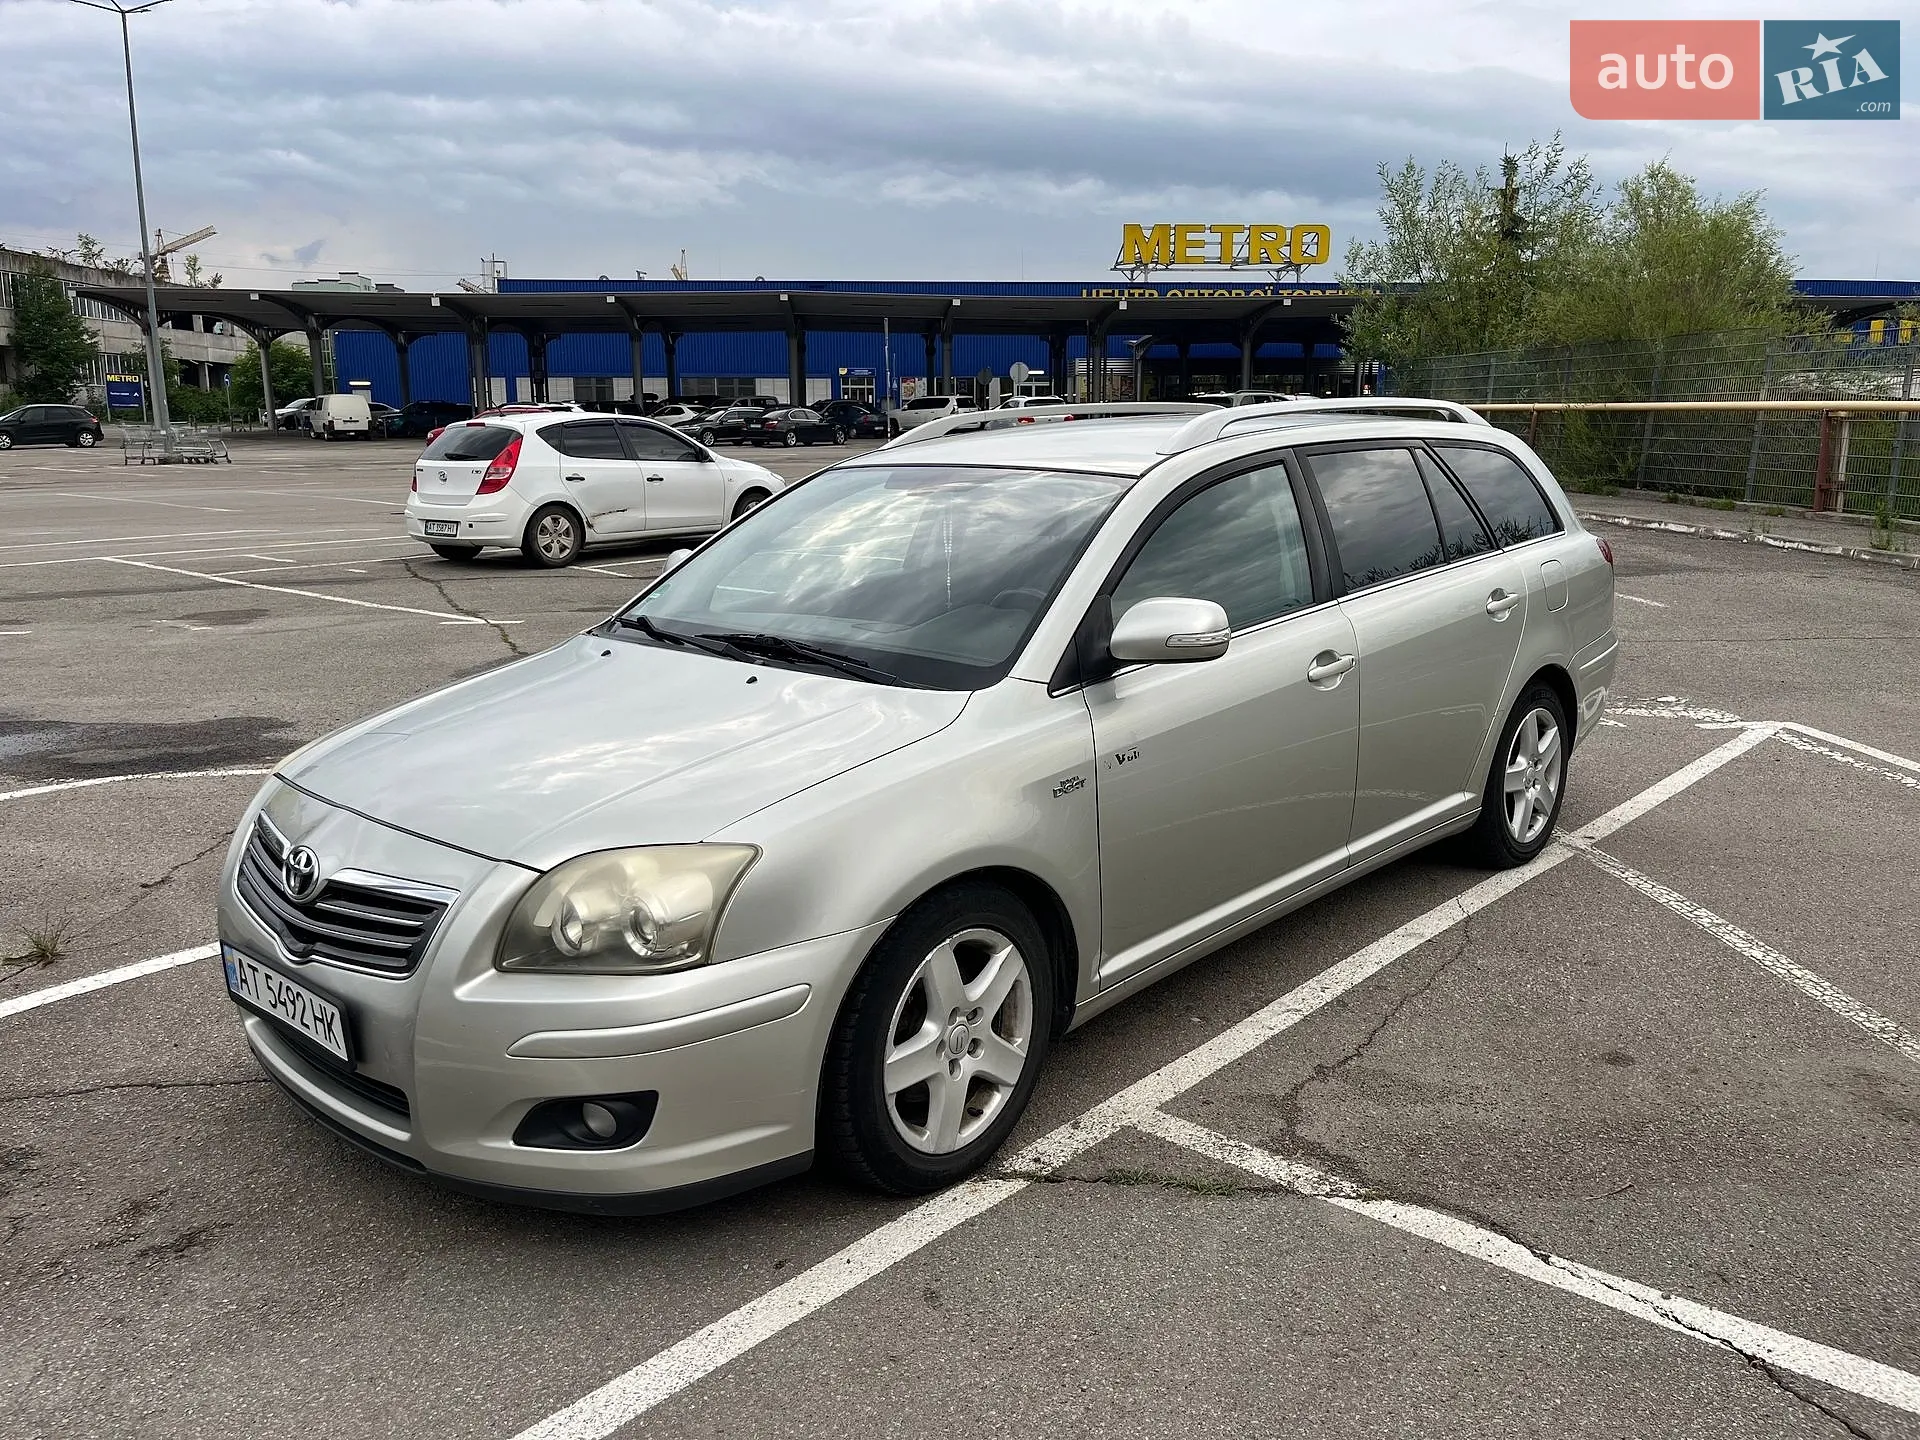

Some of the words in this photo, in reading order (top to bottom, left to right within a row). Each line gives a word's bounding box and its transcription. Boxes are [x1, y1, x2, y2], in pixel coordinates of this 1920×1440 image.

[1122, 223, 1331, 265] METRO
[106, 374, 139, 383] METRO
[238, 957, 260, 1000] AT
[264, 972, 311, 1031] 5492
[309, 997, 342, 1050] HK
